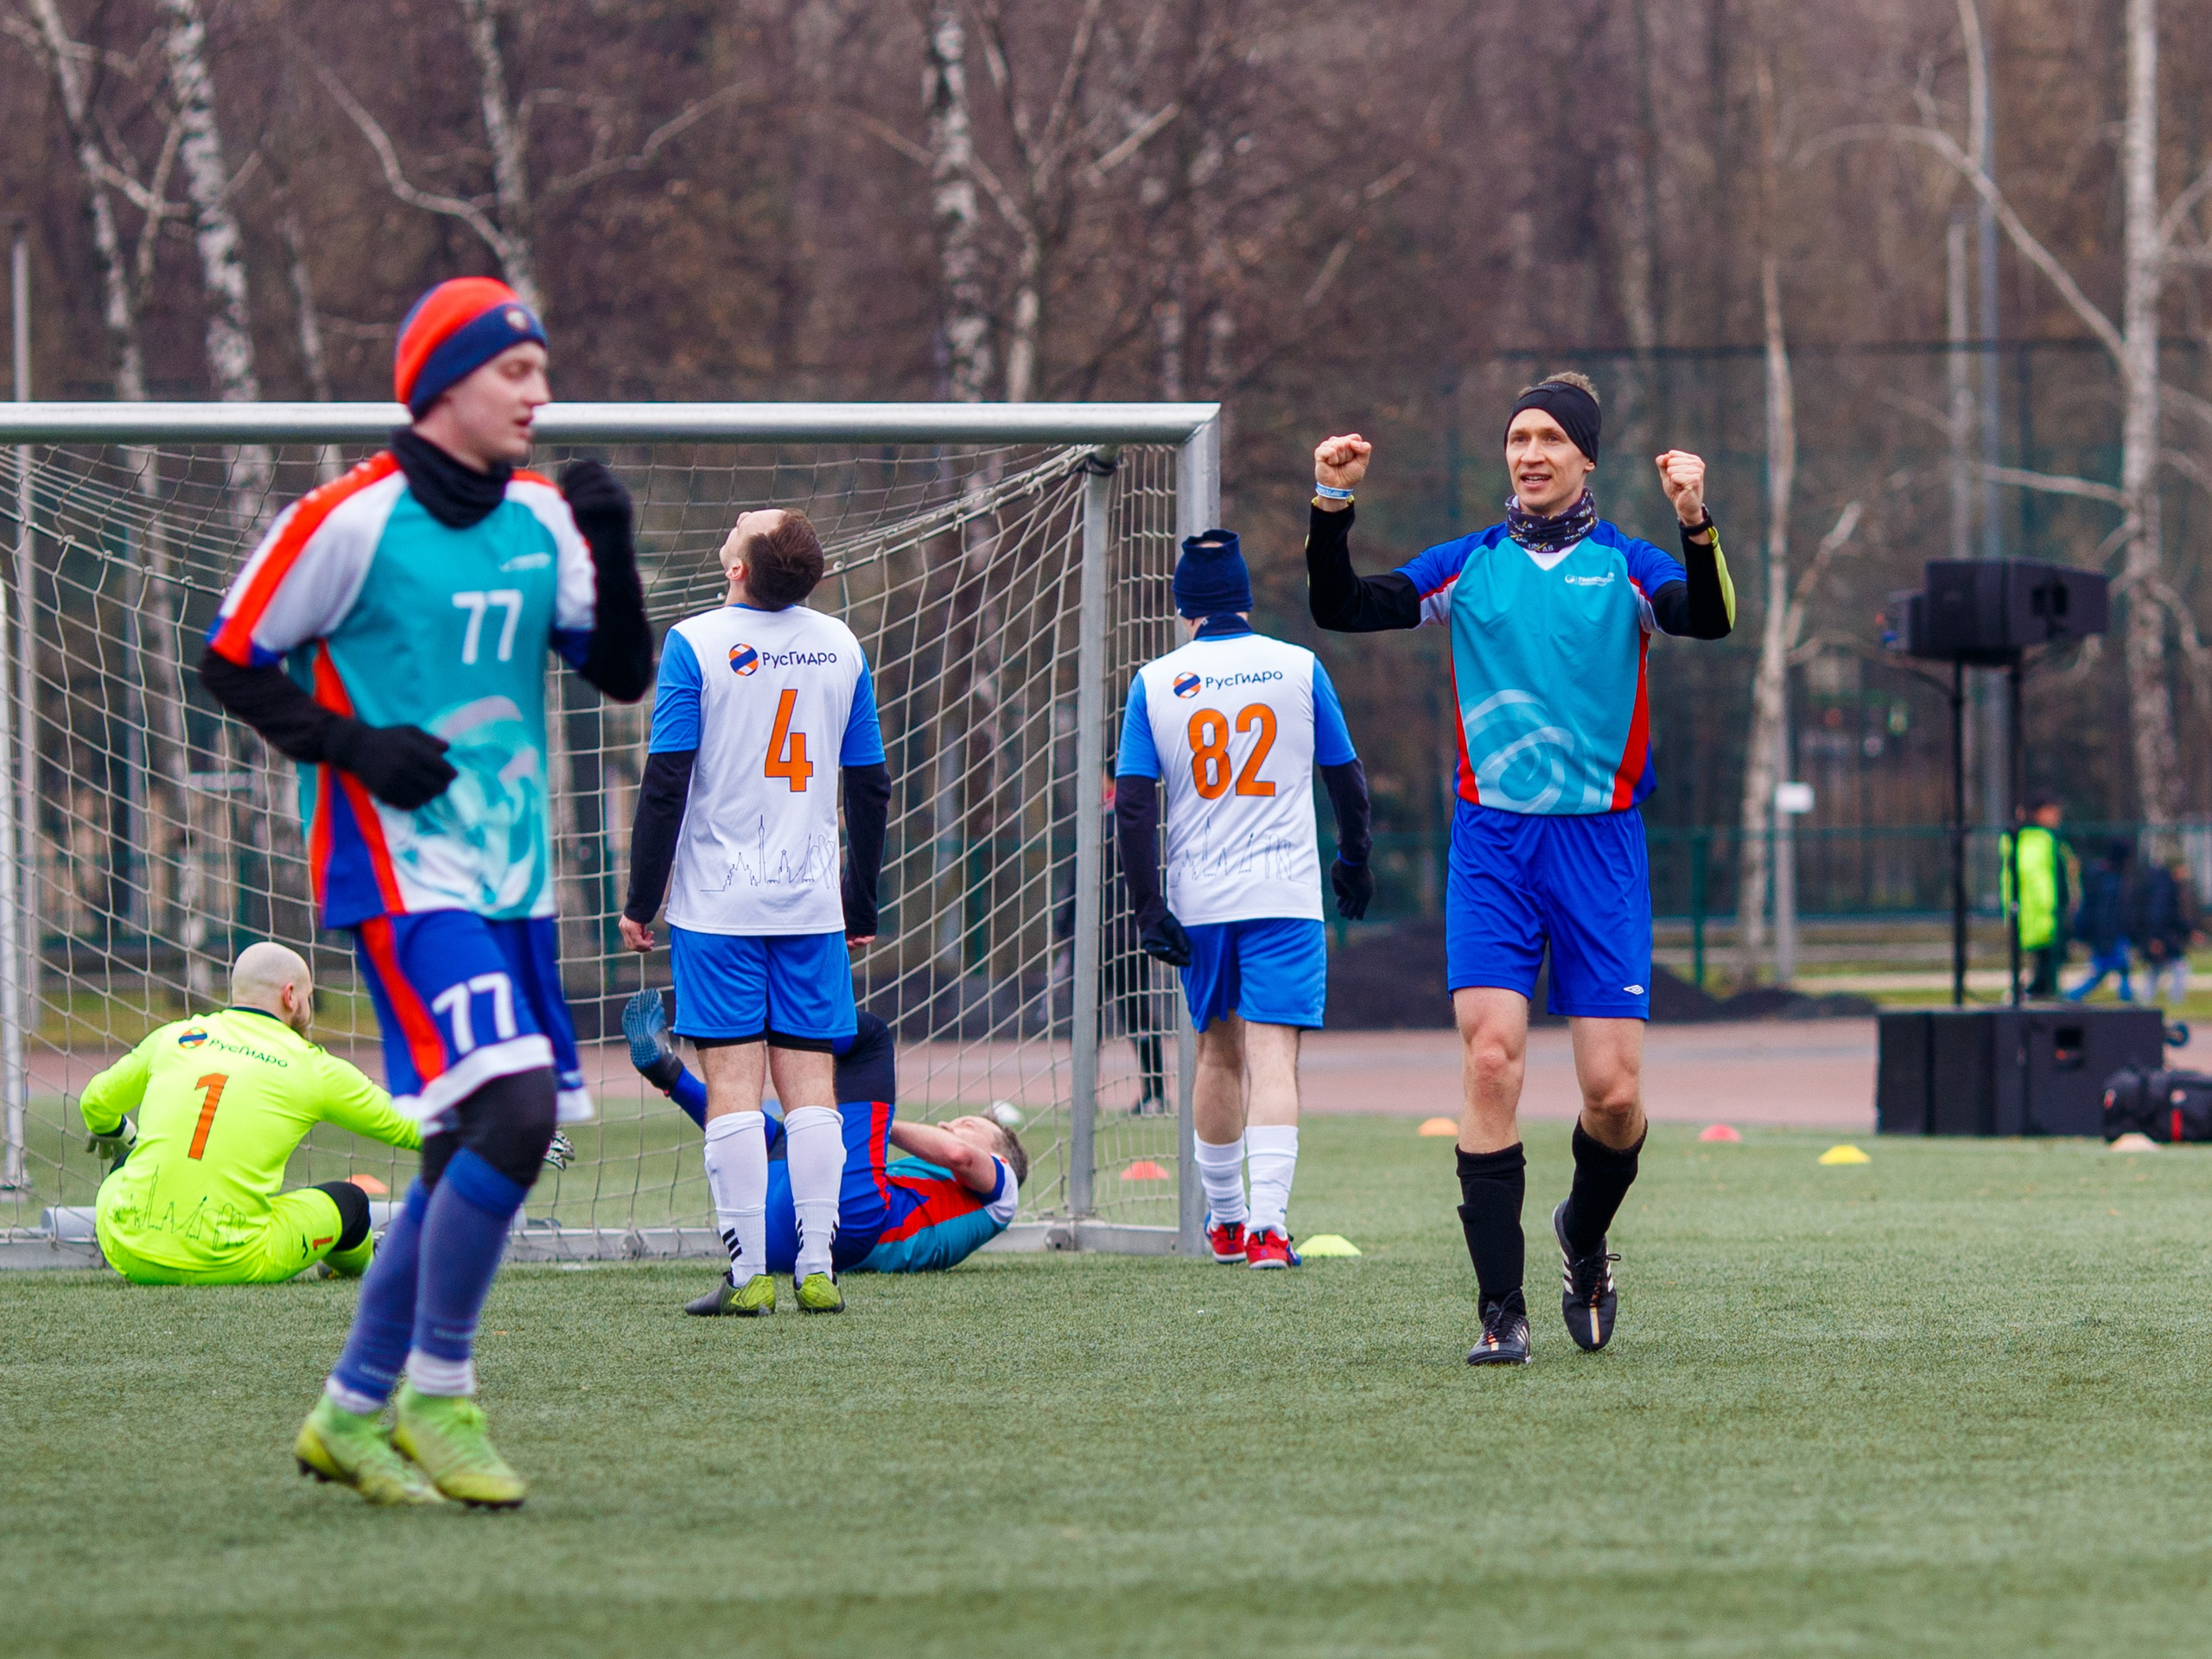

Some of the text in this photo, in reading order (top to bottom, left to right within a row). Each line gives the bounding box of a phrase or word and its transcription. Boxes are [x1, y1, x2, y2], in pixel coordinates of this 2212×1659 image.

[452, 589, 523, 665] 77
[762, 652, 837, 669] РусГидро
[1205, 671, 1283, 690] РусГидро
[765, 689, 813, 792] 4
[1187, 702, 1278, 800] 82
[431, 970, 518, 1056] 77
[188, 1072, 229, 1161] 1
